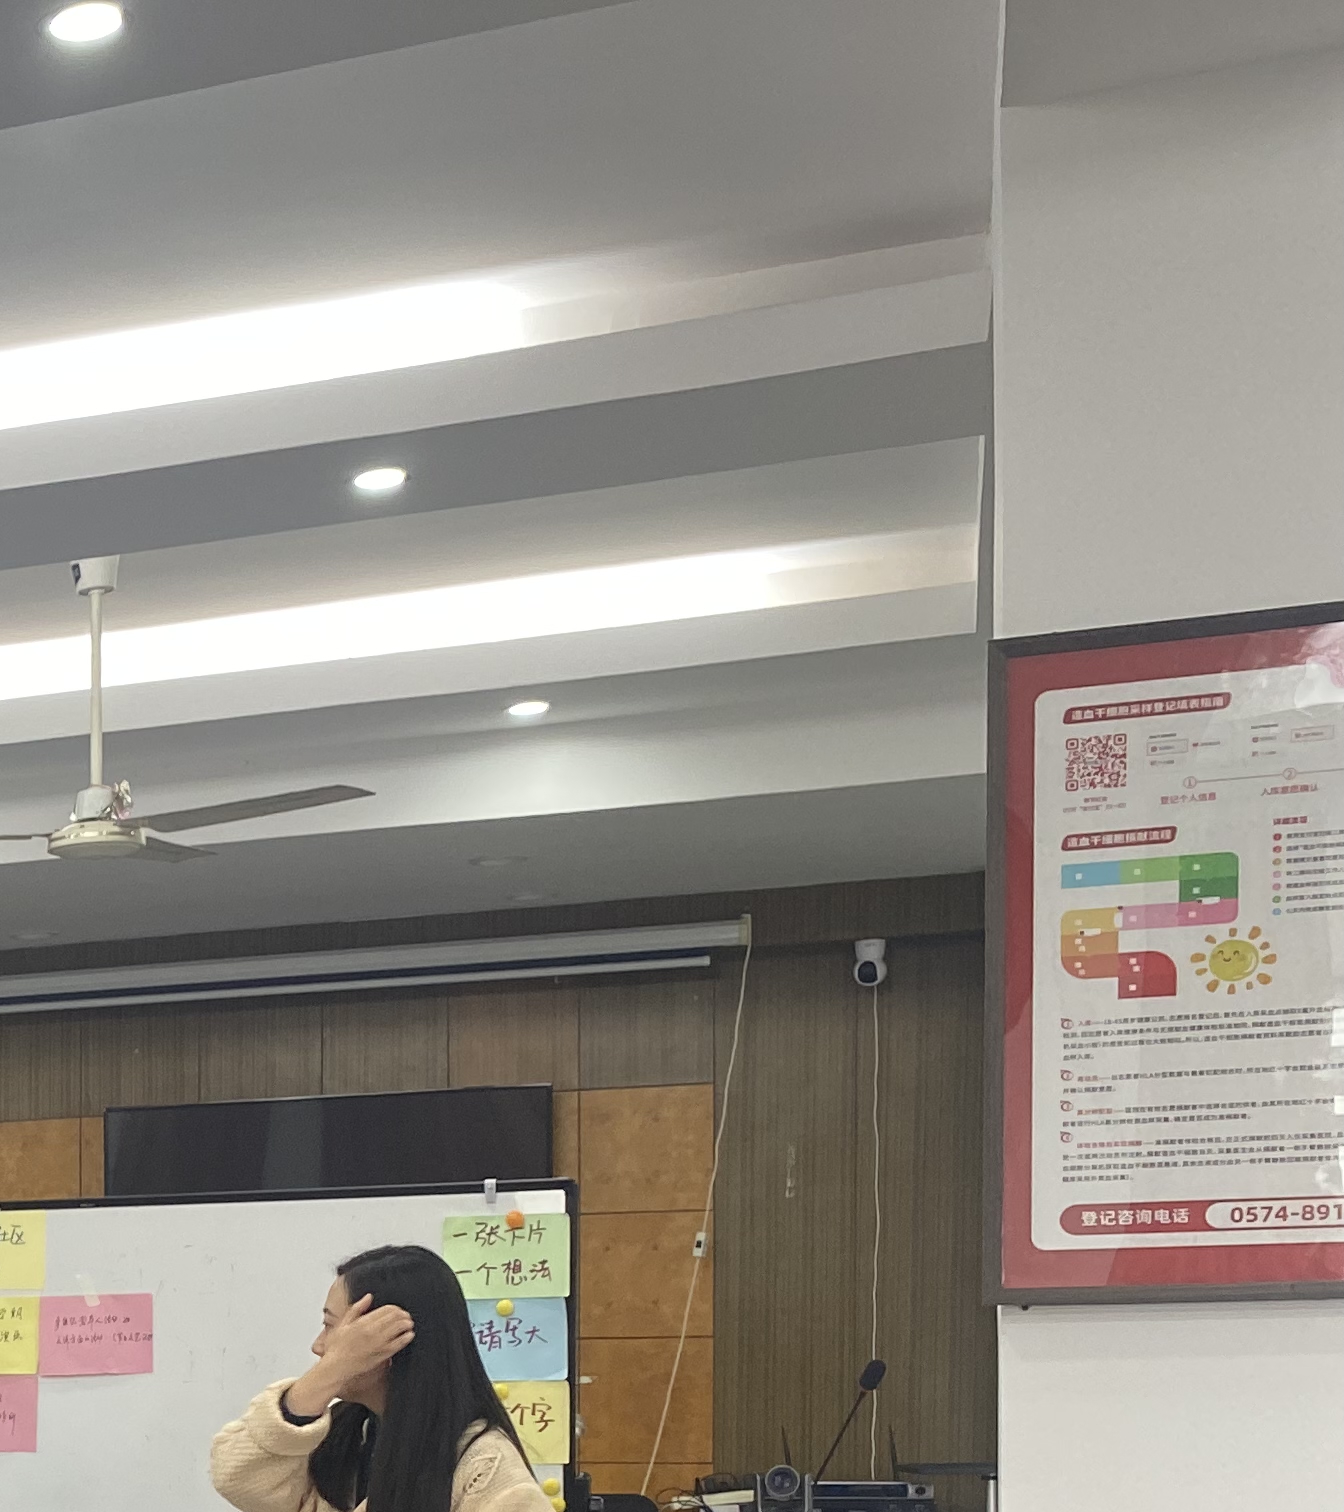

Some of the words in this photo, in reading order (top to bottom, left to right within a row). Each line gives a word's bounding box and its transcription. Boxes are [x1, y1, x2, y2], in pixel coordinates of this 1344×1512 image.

[1160, 791, 1217, 805] 登记个人信息
[1080, 1208, 1190, 1227] 登记咨询电话
[454, 1258, 552, 1286] 一个想法
[470, 1317, 549, 1352] 请写大
[503, 1396, 555, 1432] 个字
